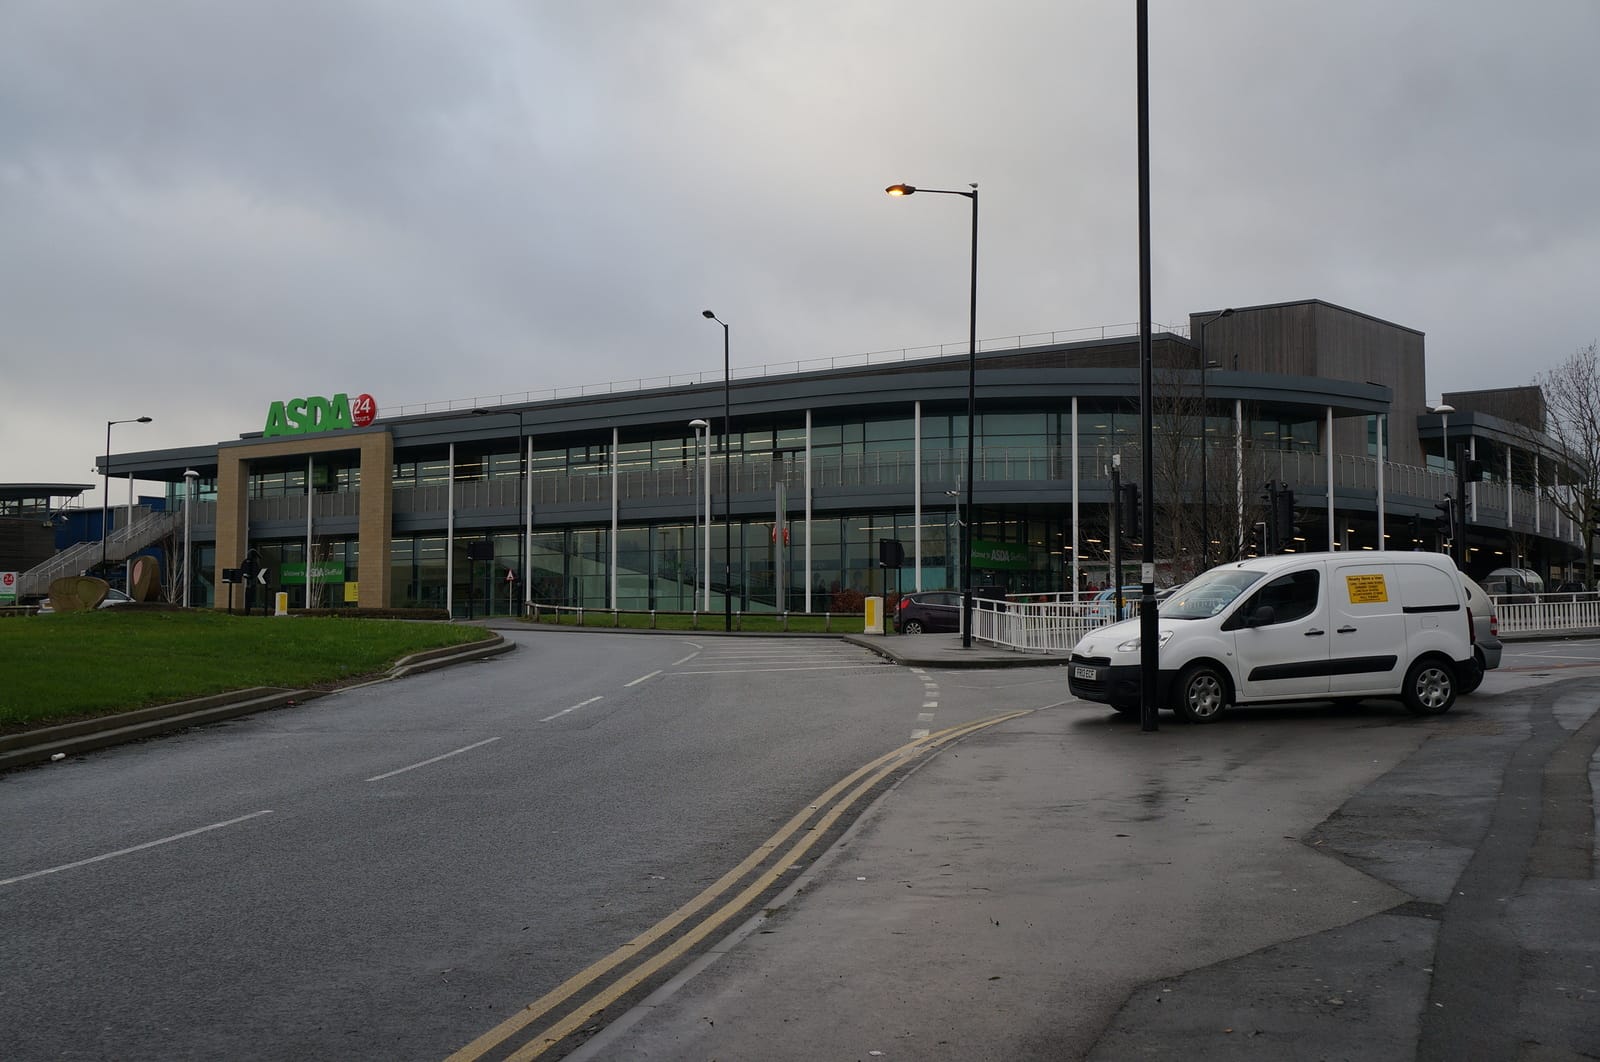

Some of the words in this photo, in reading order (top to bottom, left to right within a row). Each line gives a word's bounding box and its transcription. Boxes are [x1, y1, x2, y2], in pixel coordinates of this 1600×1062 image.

[354, 398, 371, 414] 24
[263, 393, 352, 439] ASDA
[991, 549, 1010, 562] ASDA
